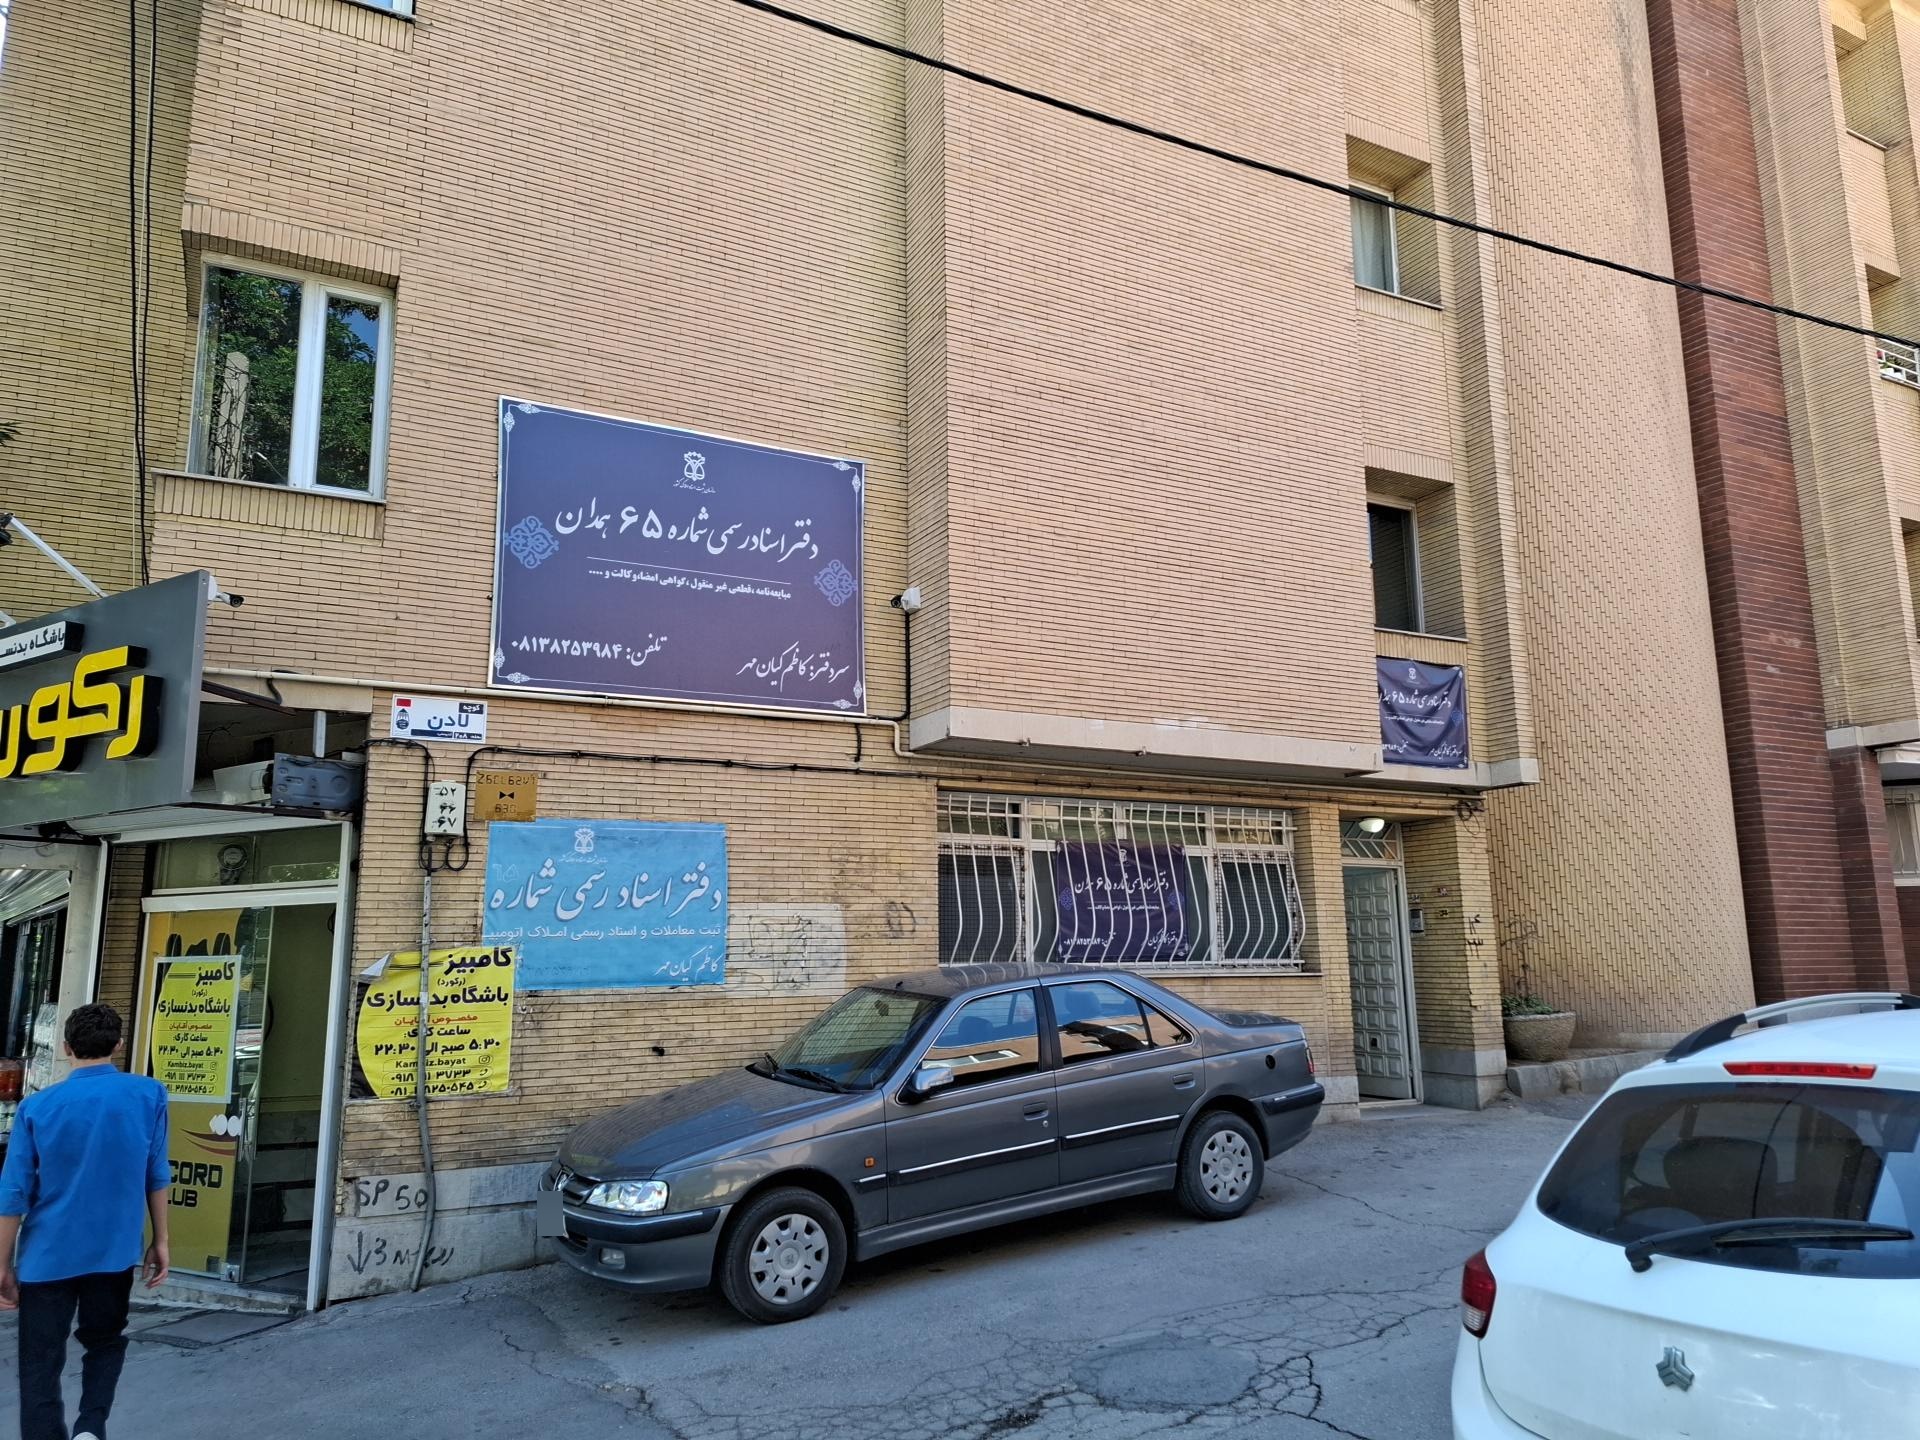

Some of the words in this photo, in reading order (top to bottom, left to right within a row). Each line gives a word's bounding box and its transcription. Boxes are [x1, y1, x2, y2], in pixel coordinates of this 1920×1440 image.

[555, 497, 611, 539] همدان
[619, 505, 663, 539] ۶۵
[667, 506, 710, 543] شماره
[706, 522, 751, 555] رسمی
[749, 527, 786, 554] اسناد
[777, 518, 819, 562] دفتر
[715, 582, 727, 592] غیر
[29, 627, 65, 650] باشگاه
[511, 635, 623, 659] ۰۸۱۳۸۲۵۳۹۸۴
[626, 633, 668, 666] تلفن:
[736, 657, 757, 676] مهر
[755, 640, 799, 686] کیان
[780, 648, 814, 693] کاظم
[462, 704, 480, 712] کوچه
[427, 713, 469, 730] لادن
[490, 857, 556, 909] شماره
[616, 872, 672, 908] اسناد
[668, 862, 722, 918] دفتر
[555, 869, 608, 921] رسمی
[527, 926, 567, 938] املاک
[570, 929, 605, 941] رسمی
[607, 925, 637, 937] اسناد
[640, 928, 647, 940] و
[651, 924, 695, 937] معاملات
[700, 924, 721, 937] ثبت
[443, 947, 513, 975] کامبیز
[196, 961, 235, 986] کامبیز
[437, 977, 466, 987] (رکورد)
[367, 990, 449, 1012] بدسازی
[451, 986, 509, 1006] باشگاه
[158, 999, 198, 1017] بدنسازی
[200, 998, 231, 1017] باشگاه
[394, 1014, 431, 1026] آایان
[432, 1014, 478, 1024] مخصوص
[190, 1032, 208, 1041] ساعت
[437, 1026, 471, 1036] ساعت
[374, 1043, 416, 1056] ۲۲:۳۰
[441, 1043, 465, 1055] صبح
[468, 1039, 500, 1051] ۵:۳۰
[396, 1057, 466, 1069] Kamiz.bayat
[391, 1073, 414, 1083] ۰۹۱۸
[436, 1069, 471, 1079] ۳۷۳۳
[168, 1188, 198, 1207] UB
